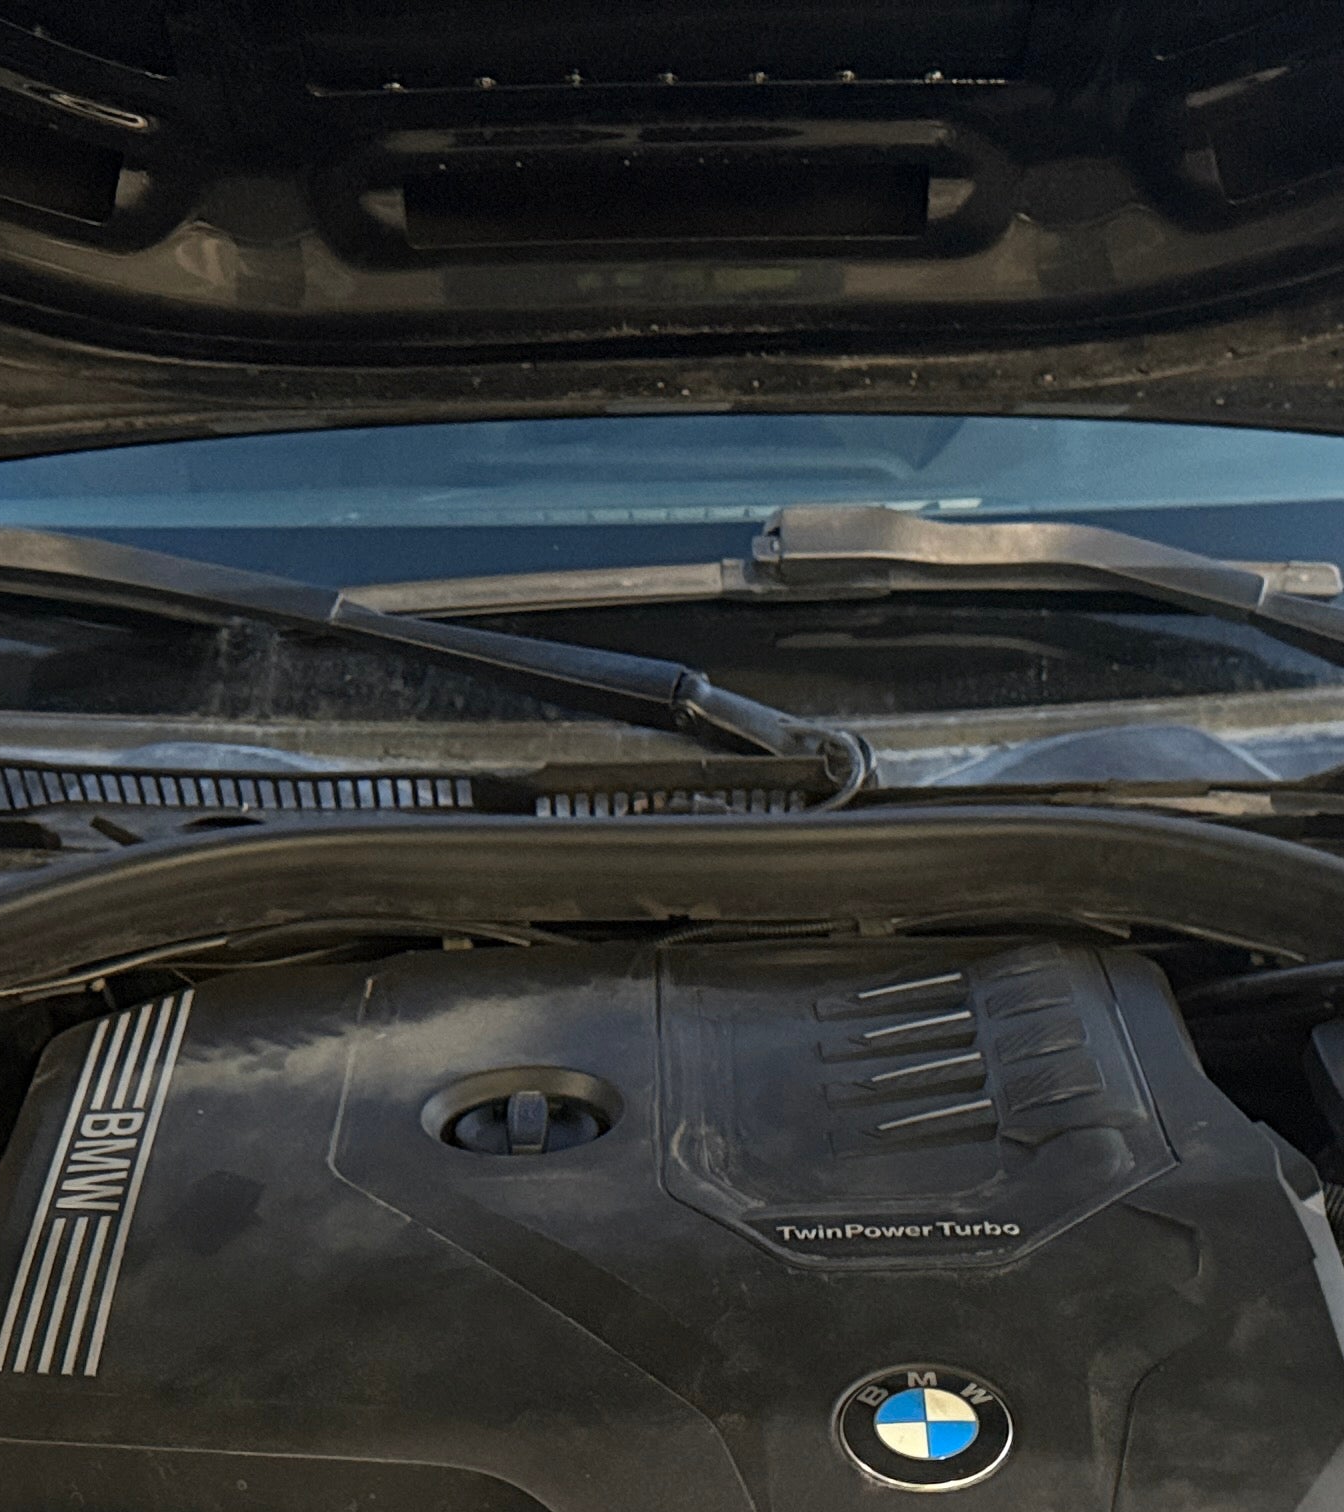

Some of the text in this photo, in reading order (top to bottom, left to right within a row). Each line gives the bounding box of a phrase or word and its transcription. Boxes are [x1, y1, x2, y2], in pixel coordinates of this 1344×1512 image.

[55, 1111, 146, 1212] BMW
[935, 1220, 1021, 1238] Turbo
[856, 1370, 995, 1408] BMW
